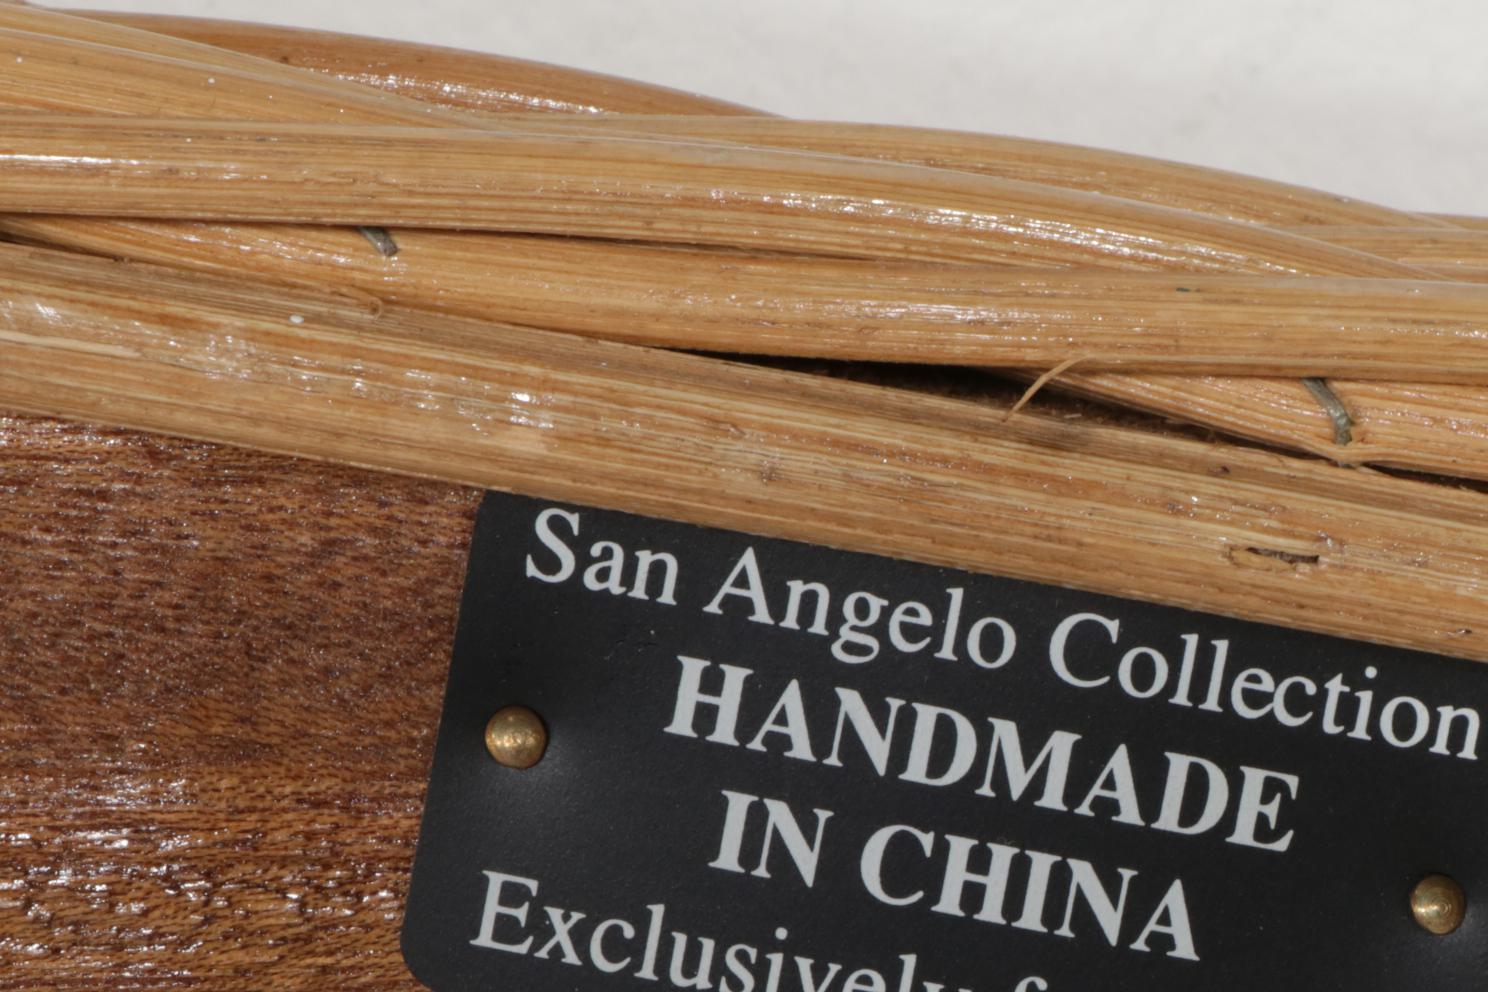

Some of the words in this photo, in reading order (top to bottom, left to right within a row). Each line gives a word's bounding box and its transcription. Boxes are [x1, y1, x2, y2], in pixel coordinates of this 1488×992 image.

[525, 507, 679, 606] San
[702, 546, 1017, 669] Angelo
[1049, 612, 1480, 761] Collection
[663, 655, 1299, 852] HANDMADE
[708, 789, 834, 888] IN
[860, 824, 1200, 961] CHINA
